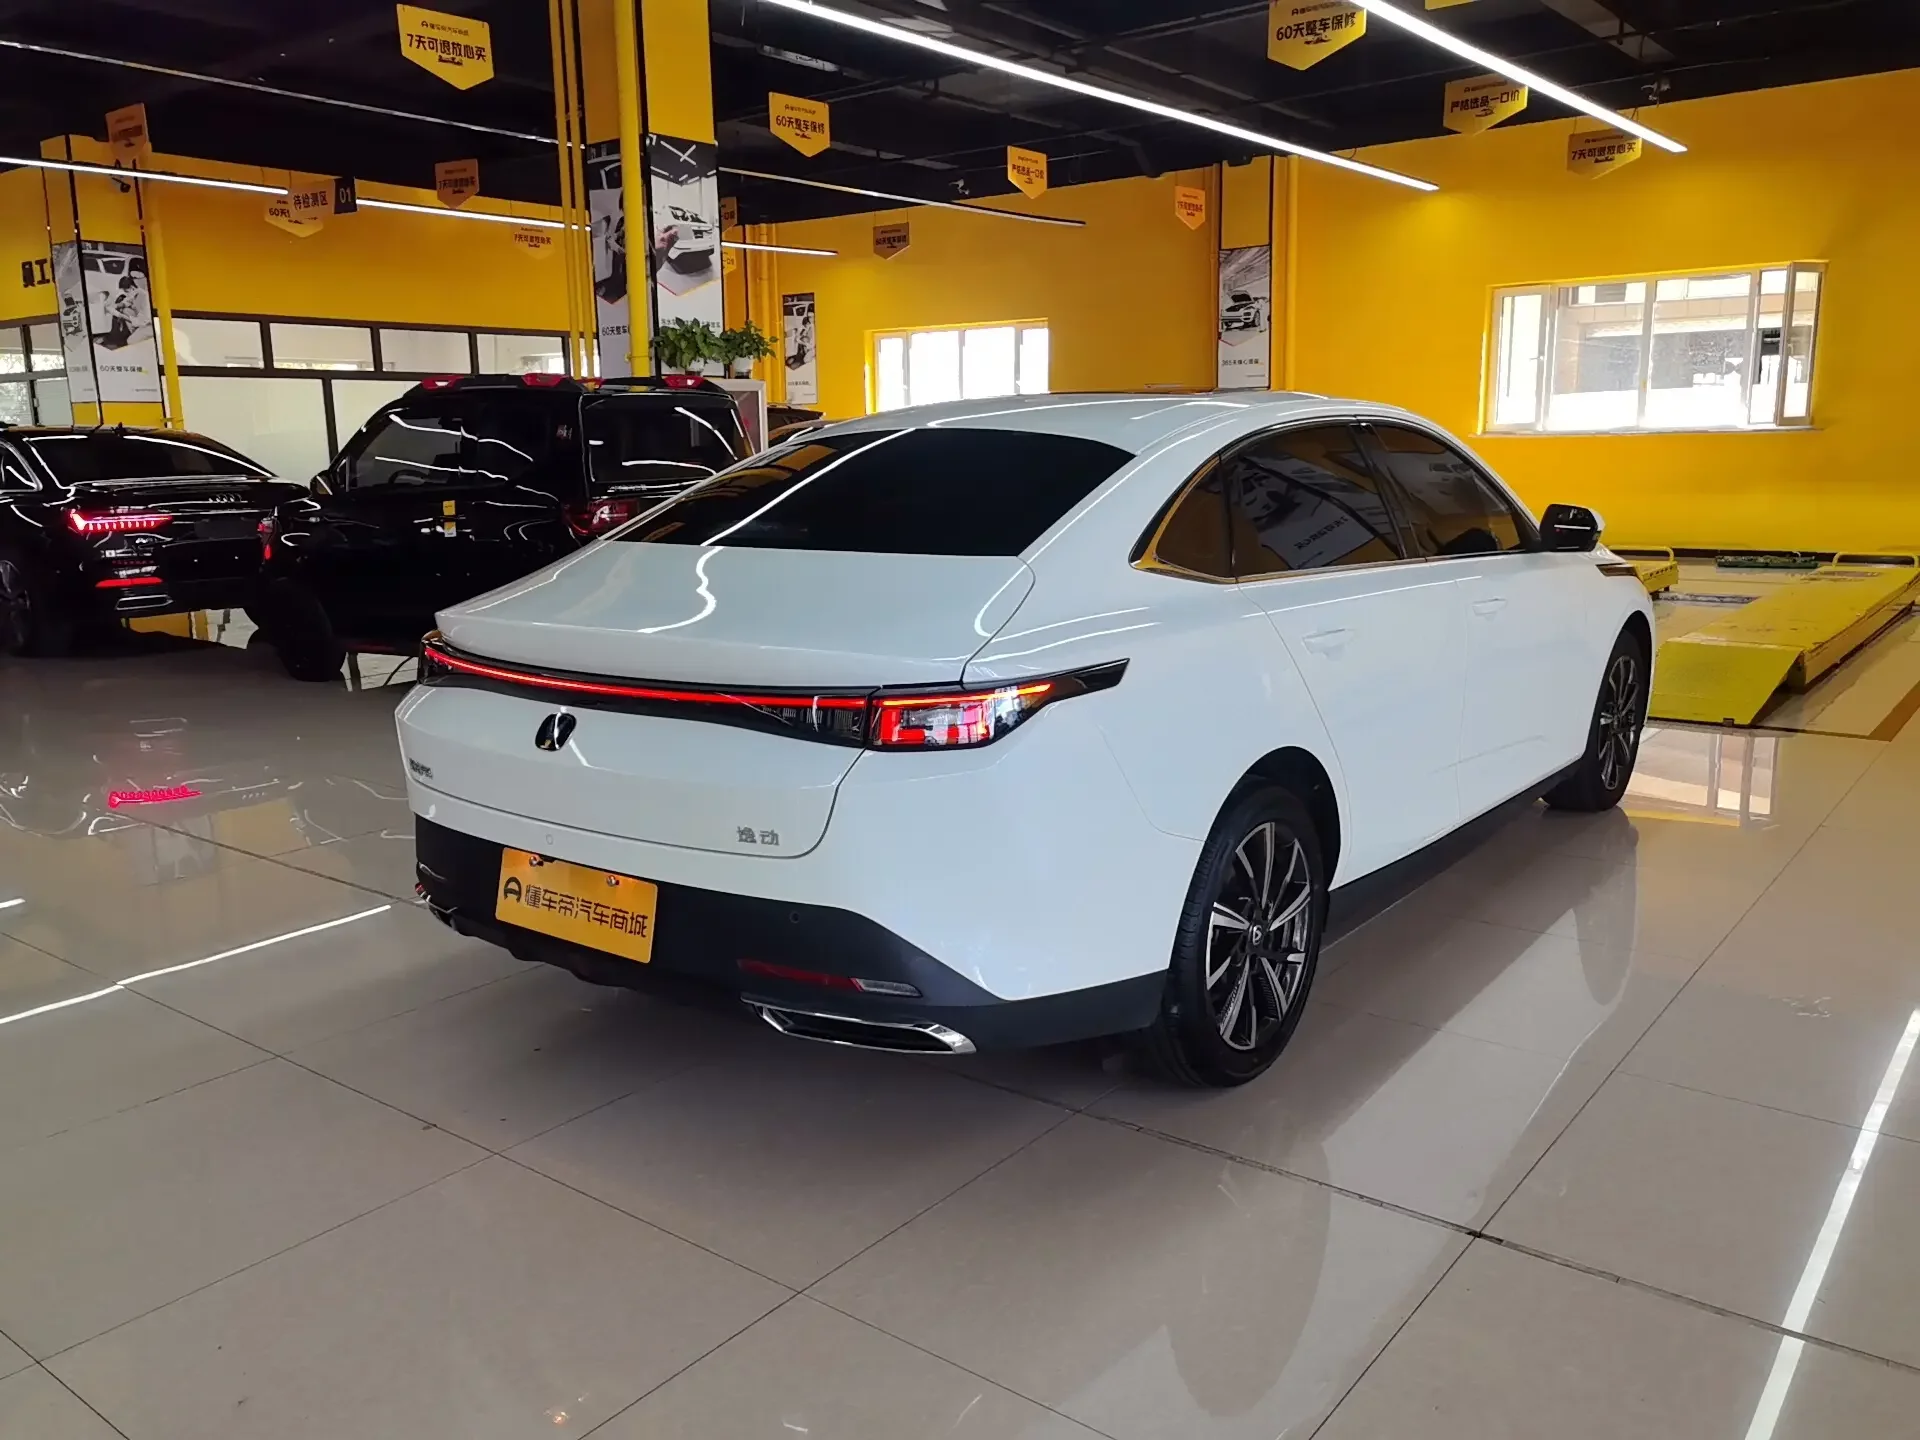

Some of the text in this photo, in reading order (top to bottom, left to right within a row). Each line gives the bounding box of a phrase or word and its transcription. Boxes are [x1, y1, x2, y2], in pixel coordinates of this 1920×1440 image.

[1276, 12, 1356, 41] 60天整车保修
[406, 33, 487, 63] 7天可退放心买
[775, 115, 825, 135] 60天整车保修
[1571, 142, 1637, 161] 7天可退放心买
[601, 325, 631, 337] 60天整车
[525, 884, 649, 938] 懂车帝汽车商城
